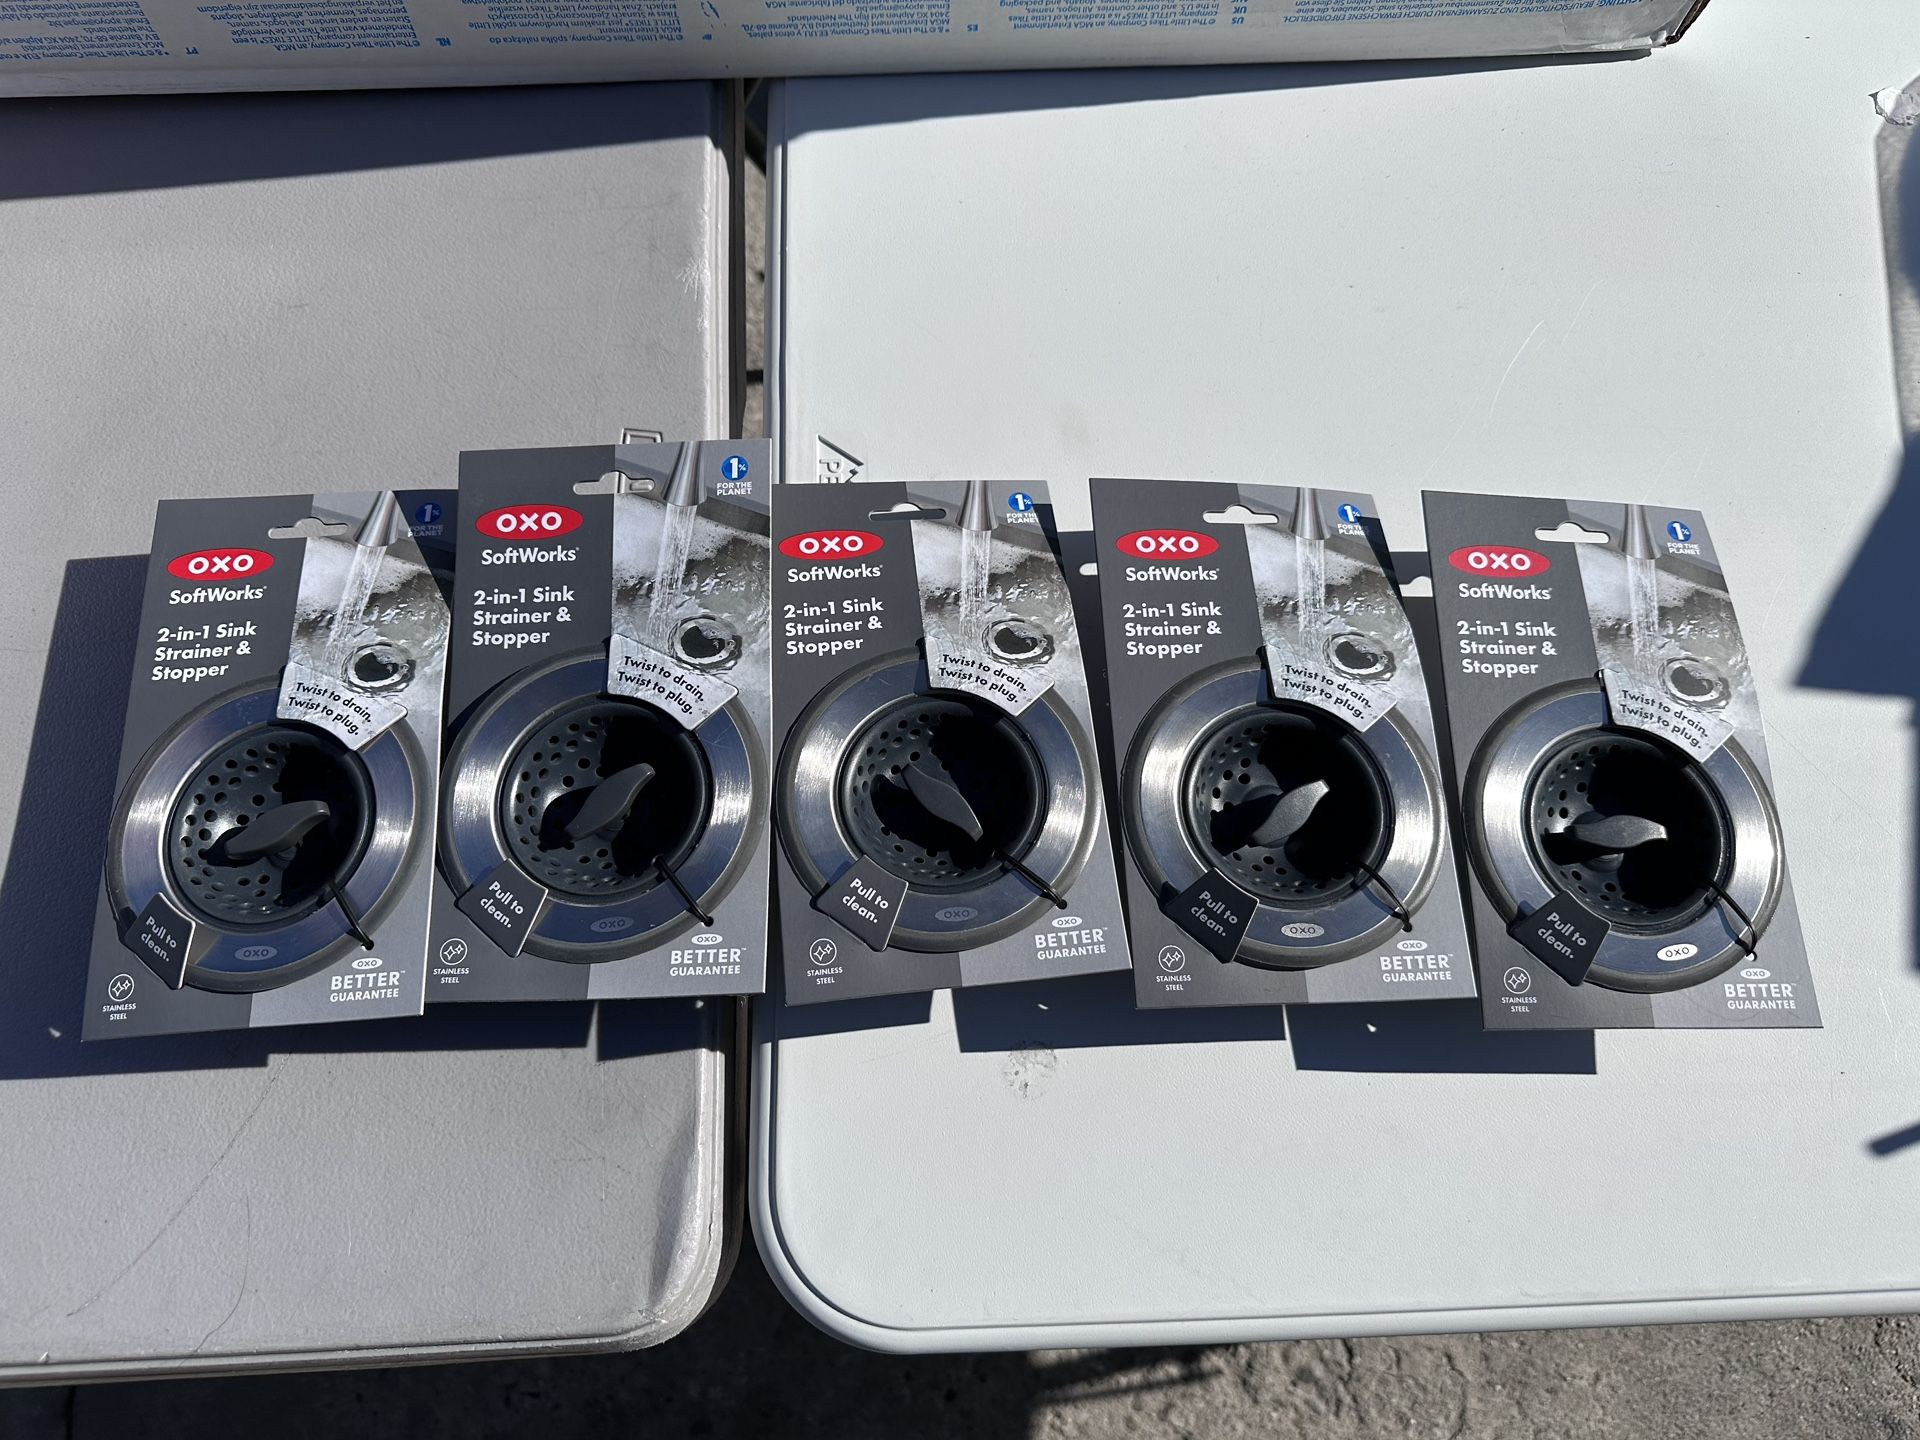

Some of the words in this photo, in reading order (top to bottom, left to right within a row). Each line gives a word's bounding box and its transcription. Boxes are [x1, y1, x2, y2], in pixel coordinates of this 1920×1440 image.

[967, 24, 979, 32] ES
[1231, 17, 1244, 25] US
[717, 488, 752, 496] PLANET
[497, 511, 563, 532] OXO
[799, 536, 864, 554] OXO
[1135, 536, 1199, 553] OXO
[1668, 547, 1701, 555] PLANET
[188, 554, 254, 575] OXO
[1467, 551, 1531, 571] OXO
[474, 588, 526, 605] 2-in-1
[533, 585, 575, 603] Sink
[473, 608, 552, 625] Strainer
[556, 607, 572, 622] &
[784, 602, 835, 618] 2-in-1
[842, 597, 884, 614] Sink
[1122, 603, 1174, 618] 2-in-1
[1180, 602, 1222, 617] Sink
[157, 626, 210, 643] 2-in-1
[216, 621, 258, 638] Sink
[785, 619, 862, 636] Strainer
[868, 616, 883, 629] &
[1125, 621, 1201, 636] Strainer
[1206, 621, 1222, 635] &
[1457, 620, 1509, 636] 2-in-1
[1515, 621, 1557, 637] Sink
[472, 631, 551, 649] Stopper
[786, 639, 864, 656] Stopper
[1459, 639, 1537, 655] Strainer
[1541, 641, 1558, 655] &
[154, 644, 233, 661] Strainer
[236, 641, 252, 655] &
[1127, 641, 1203, 659] Stopper
[152, 665, 229, 683] Stopper
[943, 654, 975, 667] Twist
[978, 662, 990, 672] to
[993, 668, 1026, 691] drain.
[1462, 659, 1539, 678] Stopper
[624, 656, 657, 672] Twist
[658, 666, 671, 678] to
[673, 675, 704, 701] drain.
[939, 667, 972, 680] Twist
[975, 675, 988, 685] to
[989, 683, 1018, 703] plug.
[1284, 665, 1319, 680] Twist
[1321, 675, 1334, 686] to
[1337, 683, 1371, 708] drain.
[296, 682, 328, 696] Twist
[328, 690, 341, 702] to
[343, 697, 372, 722] drain.
[617, 671, 651, 687] Twist
[653, 682, 666, 693] to
[665, 691, 693, 715] plug.
[1282, 678, 1317, 693] Twist
[1319, 688, 1333, 699] to
[1333, 696, 1364, 719] plug.
[288, 696, 321, 711] Twist
[321, 705, 334, 716] to
[332, 713, 359, 735] plug.
[1621, 689, 1655, 706] Twist
[1658, 701, 1671, 712] to
[1674, 710, 1707, 737] drain.
[1620, 703, 1654, 720] Twist
[1657, 716, 1670, 727] to
[1671, 725, 1701, 749] plug.
[489, 881, 514, 905] Pull
[510, 900, 524, 914] to
[850, 878, 877, 901] Pull
[875, 895, 889, 909] to
[480, 898, 511, 928] clean.
[842, 895, 878, 923] clean.
[944, 909, 971, 919] OXO
[1199, 890, 1226, 914] Pull
[1224, 910, 1238, 924] to
[599, 918, 626, 930] OXO
[1056, 918, 1079, 926] OXO
[1191, 906, 1227, 937] clean.
[1289, 925, 1316, 935] OXO
[1546, 912, 1575, 936] Pull
[1573, 931, 1587, 946] to
[146, 916, 167, 939] Pull
[165, 935, 177, 948] to
[696, 935, 718, 943] OXO
[1035, 929, 1104, 948] BETTER
[141, 933, 170, 962] clean.
[1037, 944, 1107, 960] GUARANTEE
[1537, 928, 1574, 958] clean.
[1665, 946, 1690, 958] OXO
[242, 948, 270, 958] OXO
[671, 948, 741, 964] BETTER
[1380, 954, 1450, 970] BETTER
[356, 959, 379, 968] OXO
[433, 967, 470, 975] STAINLESS
[670, 965, 741, 976] GUARANTEE
[806, 966, 843, 976] STAINLESS
[331, 971, 400, 990] BETTER
[440, 976, 460, 984] STEEL
[816, 976, 835, 984] STEEL
[1155, 974, 1192, 982] STAINLESS
[1382, 971, 1452, 982] GUARANTEE
[1745, 970, 1766, 978] OXO
[329, 988, 400, 1002] GUARANTEE
[1723, 983, 1793, 998] BETTER
[102, 1003, 137, 1012] STAINLESS
[1501, 996, 1537, 1004] STAINLESS
[1726, 1000, 1796, 1010] GUARANTEE
